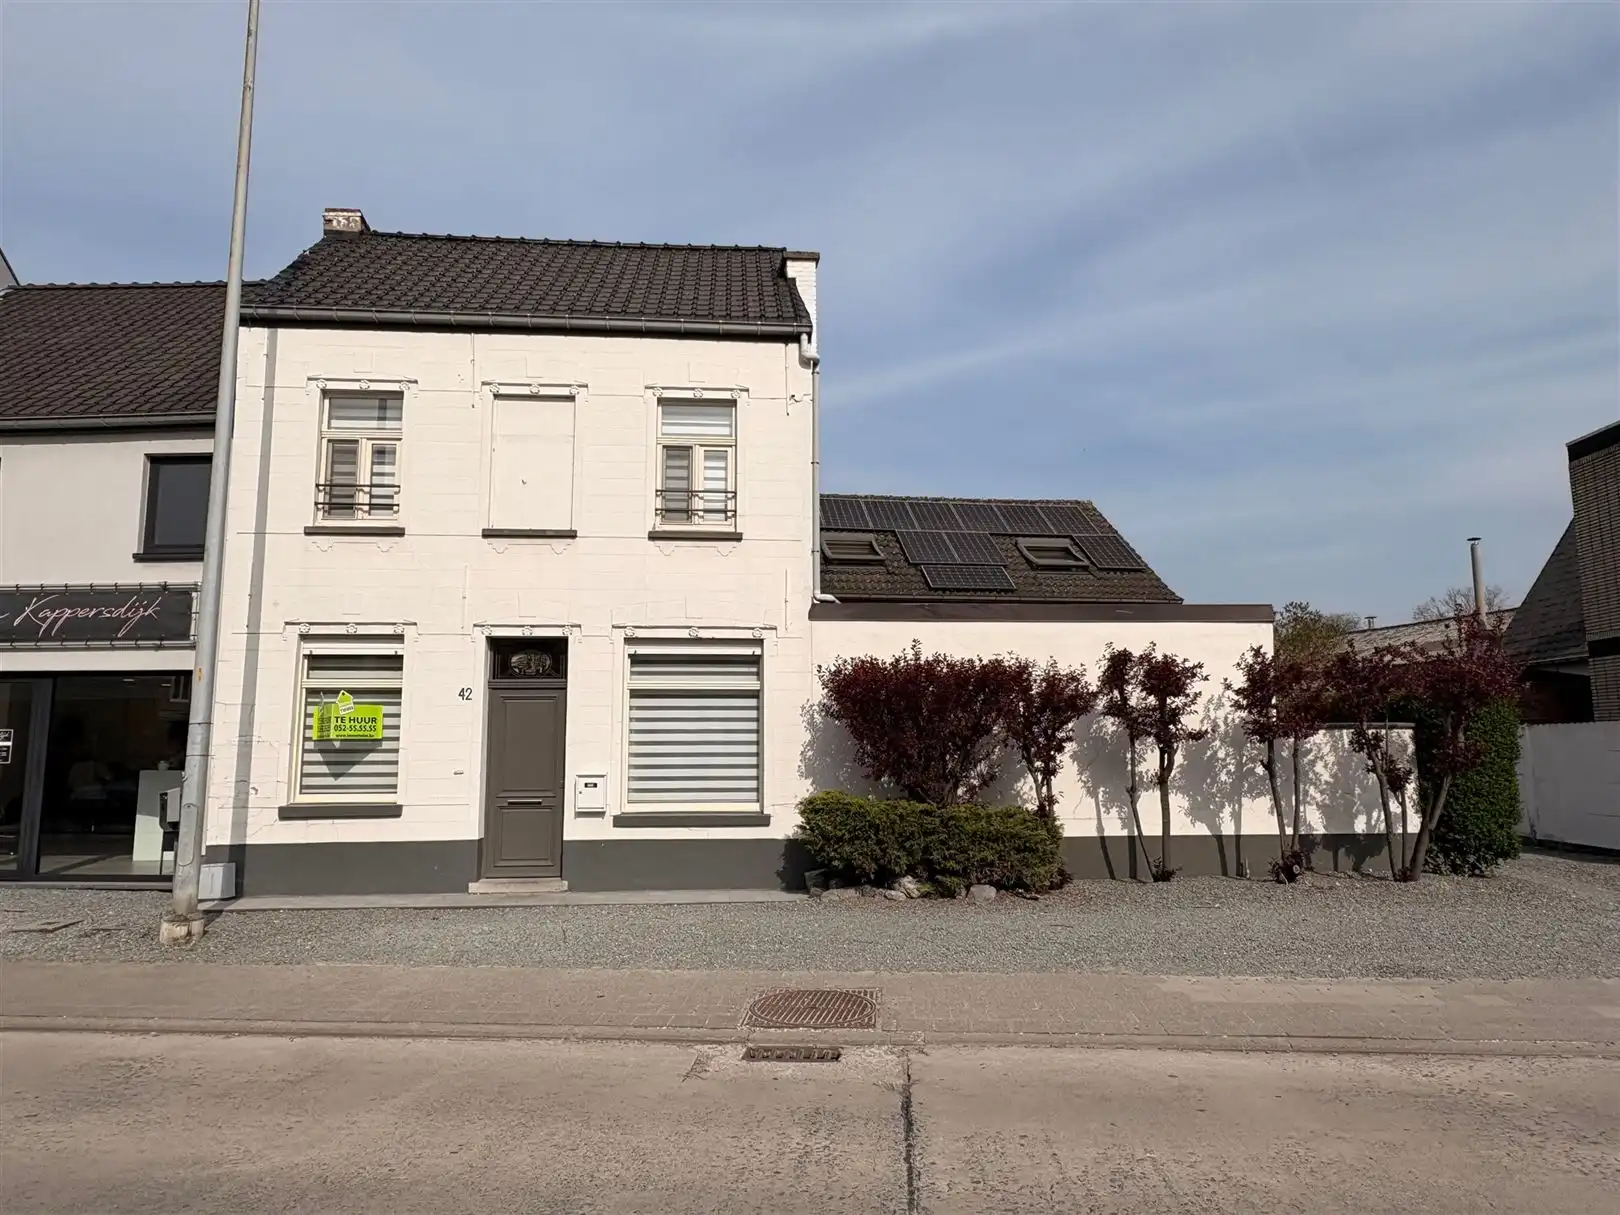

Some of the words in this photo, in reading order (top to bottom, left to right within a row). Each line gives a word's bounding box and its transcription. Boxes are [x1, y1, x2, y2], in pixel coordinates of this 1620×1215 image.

[13, 594, 162, 638] Kappersdijk
[458, 687, 473, 701] 42
[334, 716, 346, 724] TE
[348, 716, 377, 724] HUUR
[333, 724, 377, 732] 052-55.55.55
